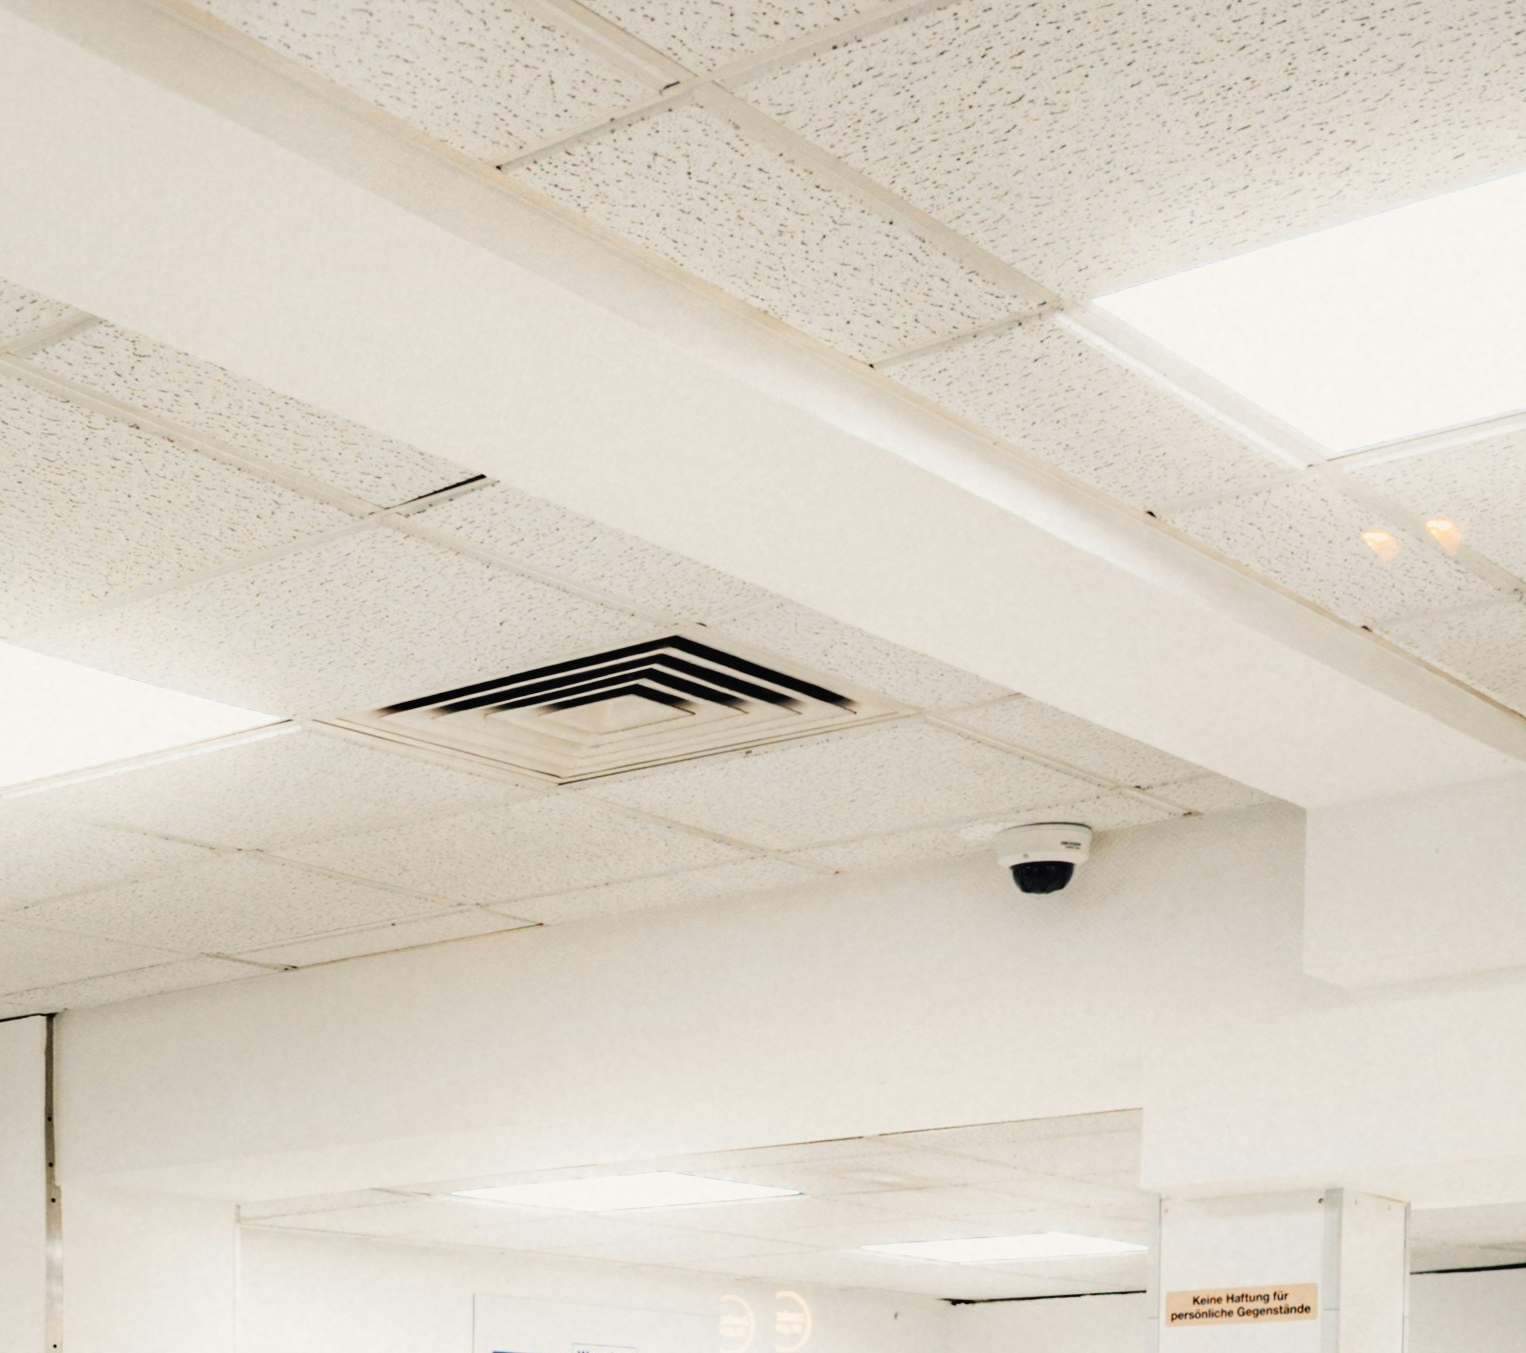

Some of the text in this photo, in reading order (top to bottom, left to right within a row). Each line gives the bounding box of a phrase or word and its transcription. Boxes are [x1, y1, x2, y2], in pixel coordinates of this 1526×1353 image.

[1192, 1290, 1289, 1305] Keine Haftung für
[1170, 1303, 1311, 1321] persönliche Gegenstände
